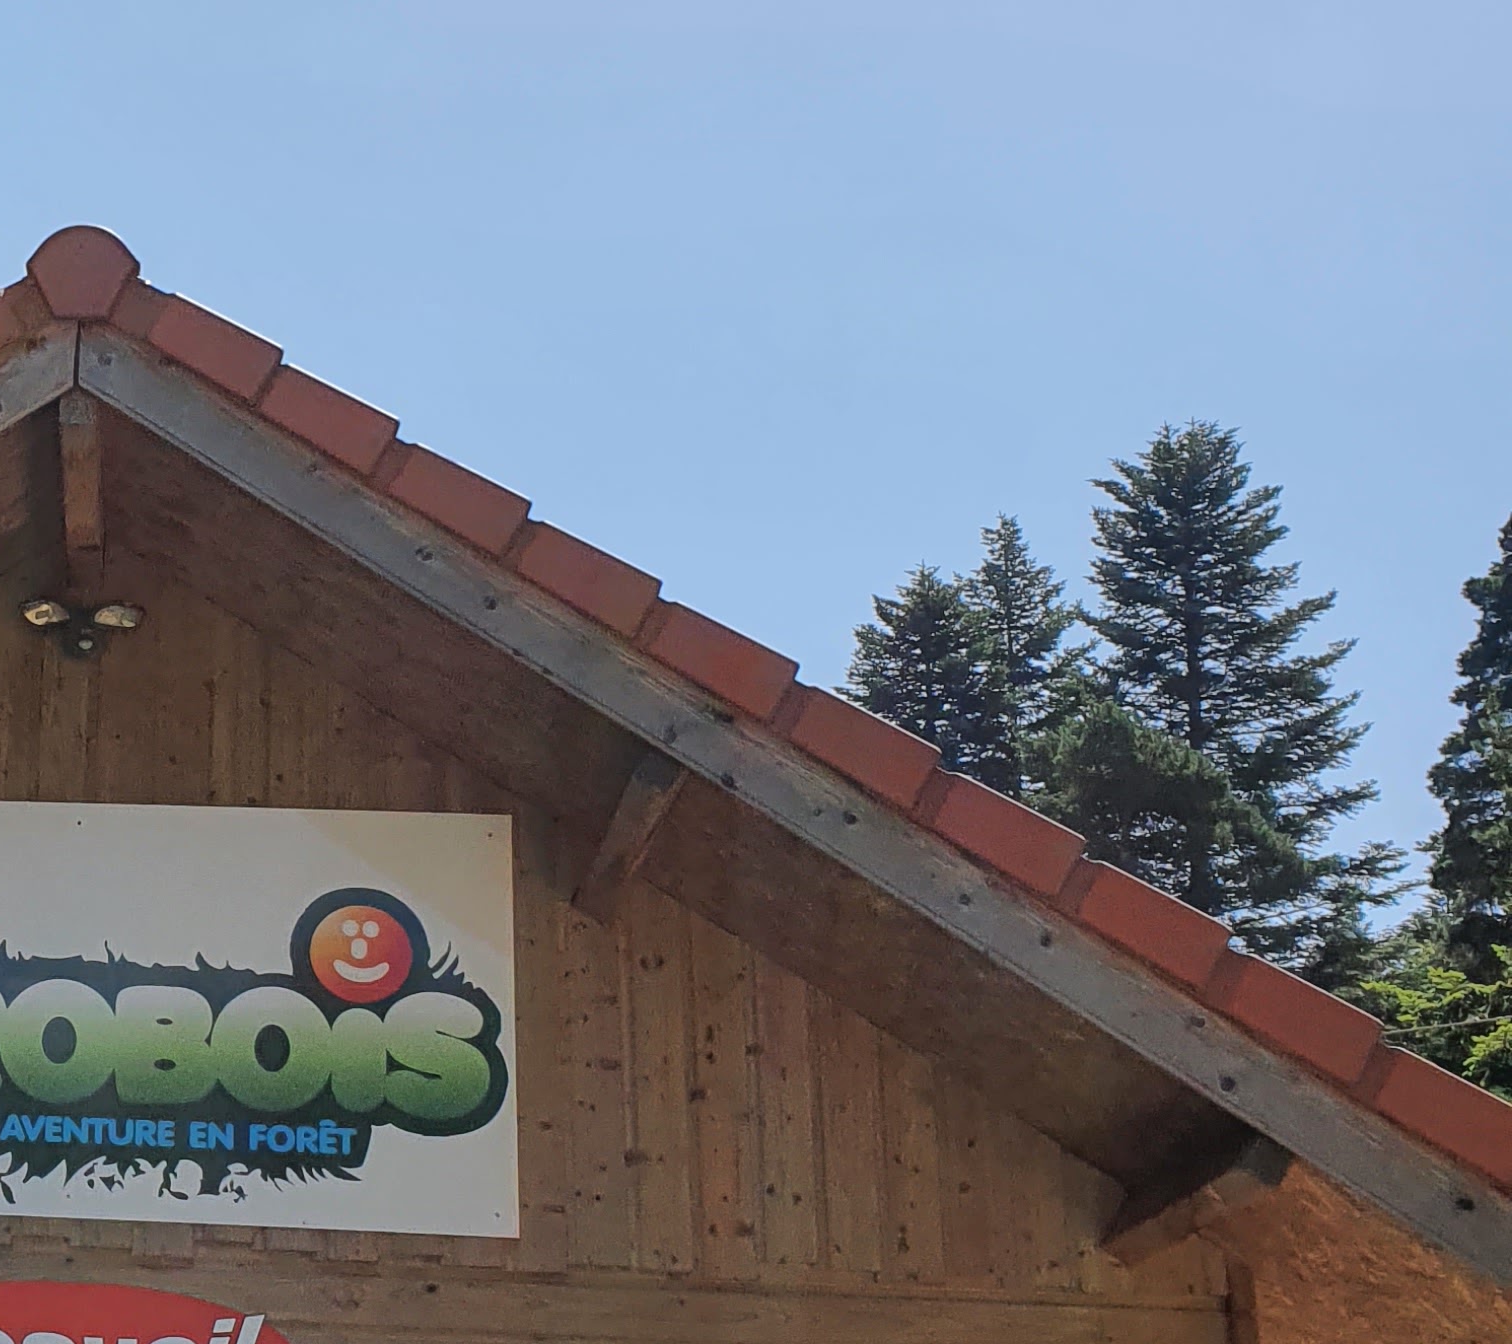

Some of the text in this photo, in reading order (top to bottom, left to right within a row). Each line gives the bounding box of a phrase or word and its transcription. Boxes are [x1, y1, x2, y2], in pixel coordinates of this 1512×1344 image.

[0, 1113, 176, 1148] AVENTURE
[188, 1120, 235, 1151] EN
[248, 1118, 358, 1156] FORÊT
